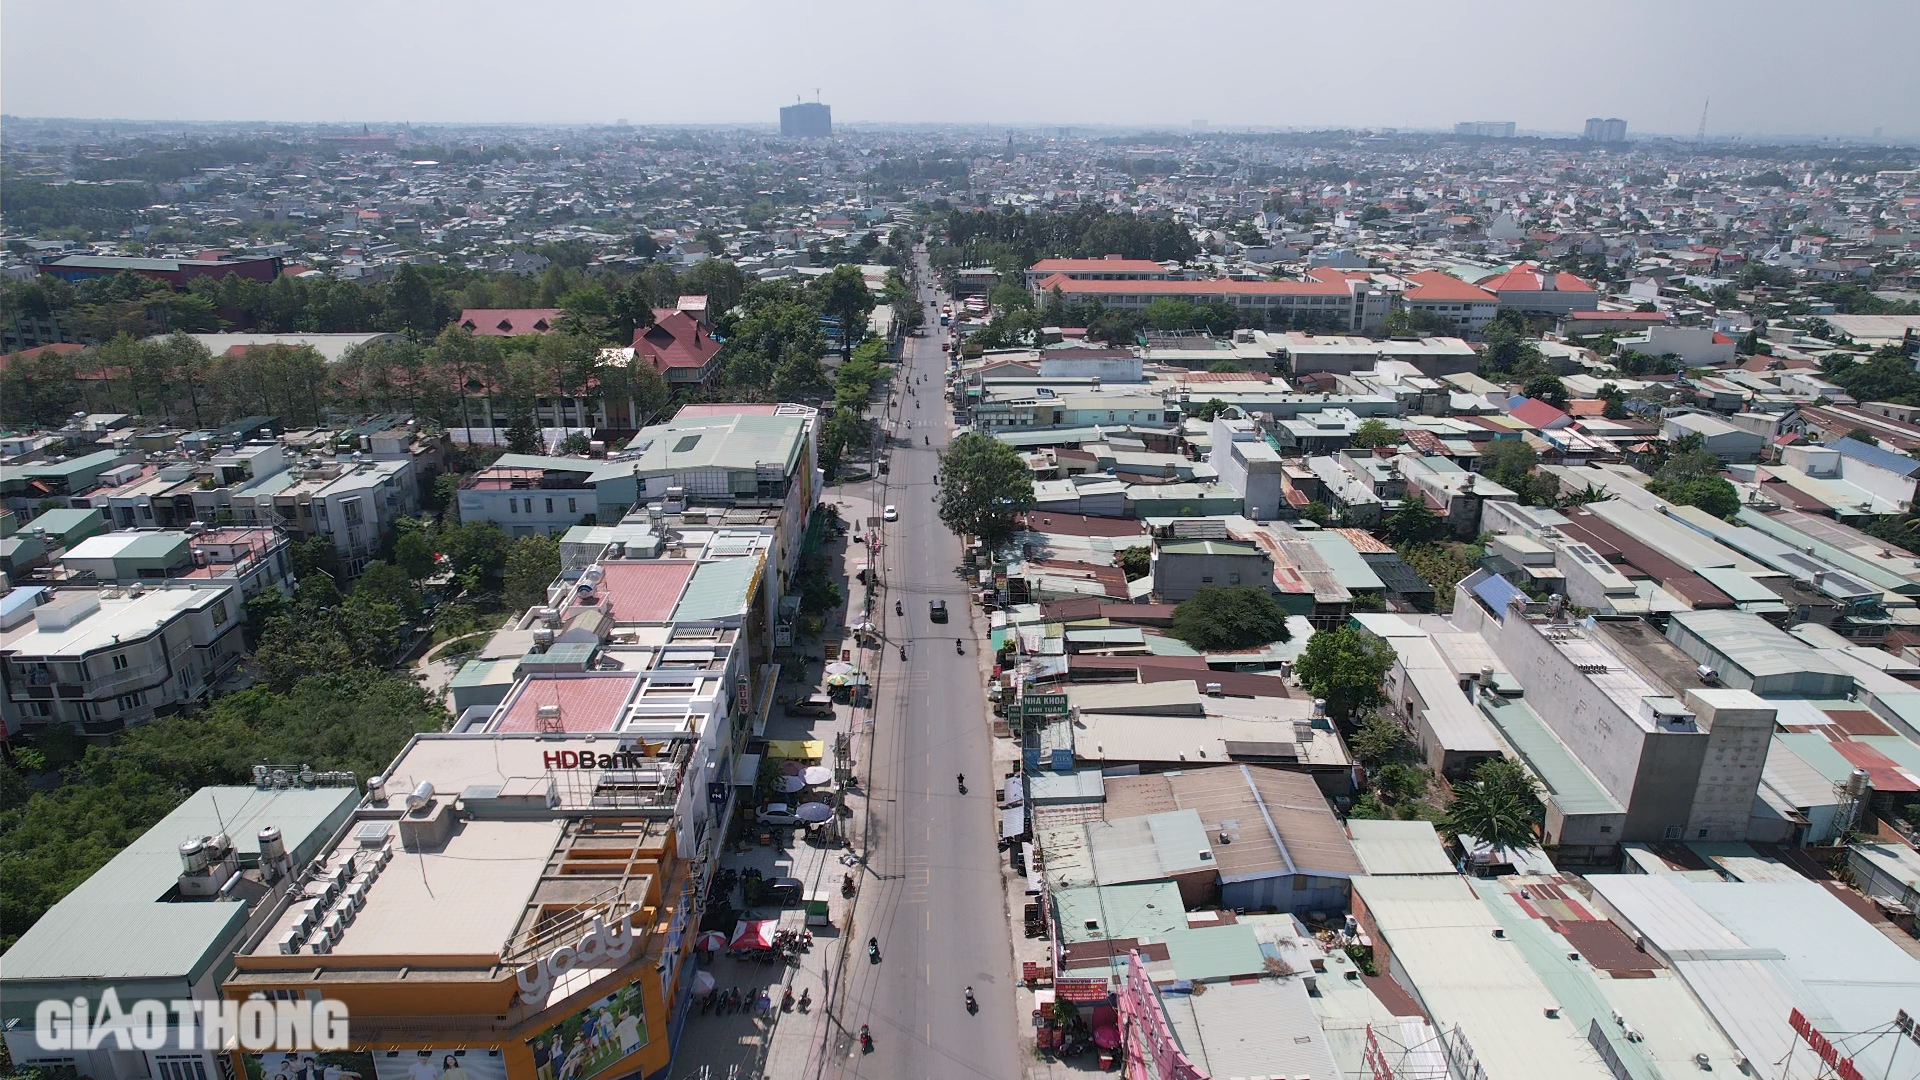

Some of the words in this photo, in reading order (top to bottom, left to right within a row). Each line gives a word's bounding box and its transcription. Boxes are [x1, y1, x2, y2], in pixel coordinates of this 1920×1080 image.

[738, 684, 748, 711] RUBY
[1043, 696, 1066, 704] KHOA
[543, 749, 643, 770] HDBank
[516, 901, 640, 1005] yody
[1808, 1027, 1839, 1070] KHOA
